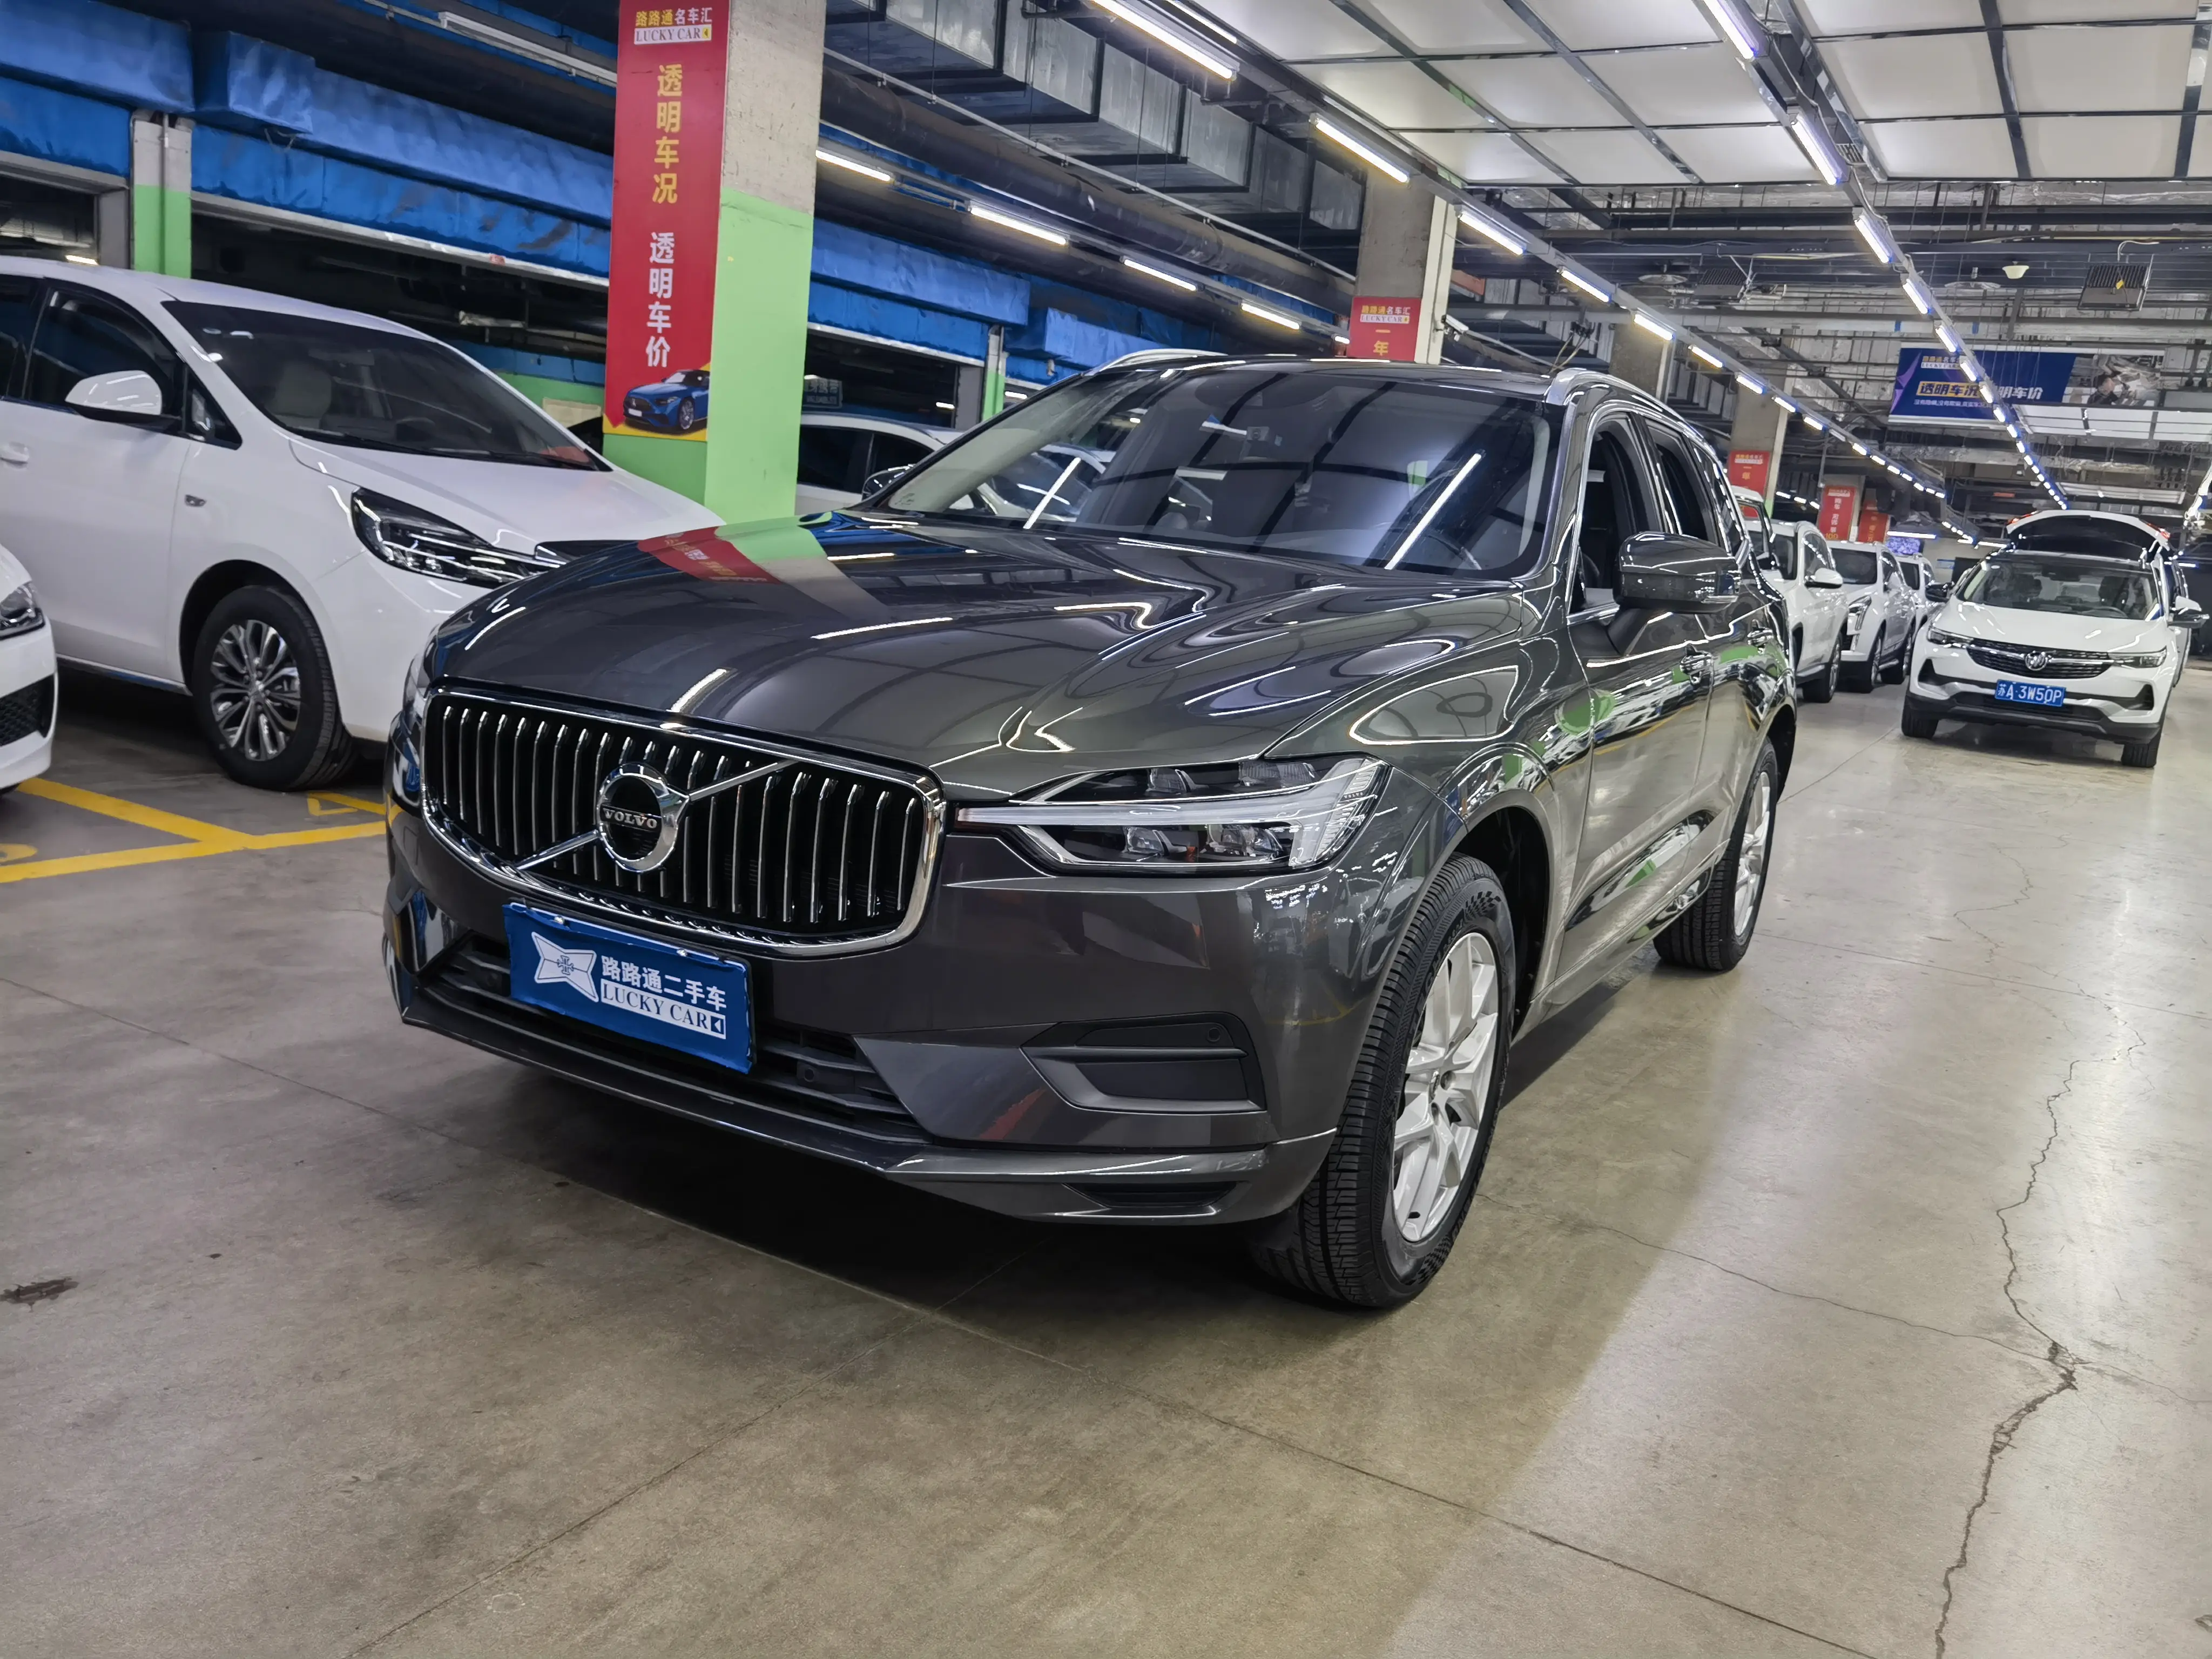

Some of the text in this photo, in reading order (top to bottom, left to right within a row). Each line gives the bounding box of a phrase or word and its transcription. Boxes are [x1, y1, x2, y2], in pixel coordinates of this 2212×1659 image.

[636, 28, 700, 42] LUCKY CAR
[652, 64, 683, 204] 透明车况
[645, 232, 675, 367] 透明车价
[1920, 383, 1980, 396] 透明车况
[1999, 386, 2044, 400] 明车价
[603, 807, 657, 829] VOLVO
[601, 955, 727, 1011] 路路通二手车
[603, 983, 709, 1030] LUCKY CAR
